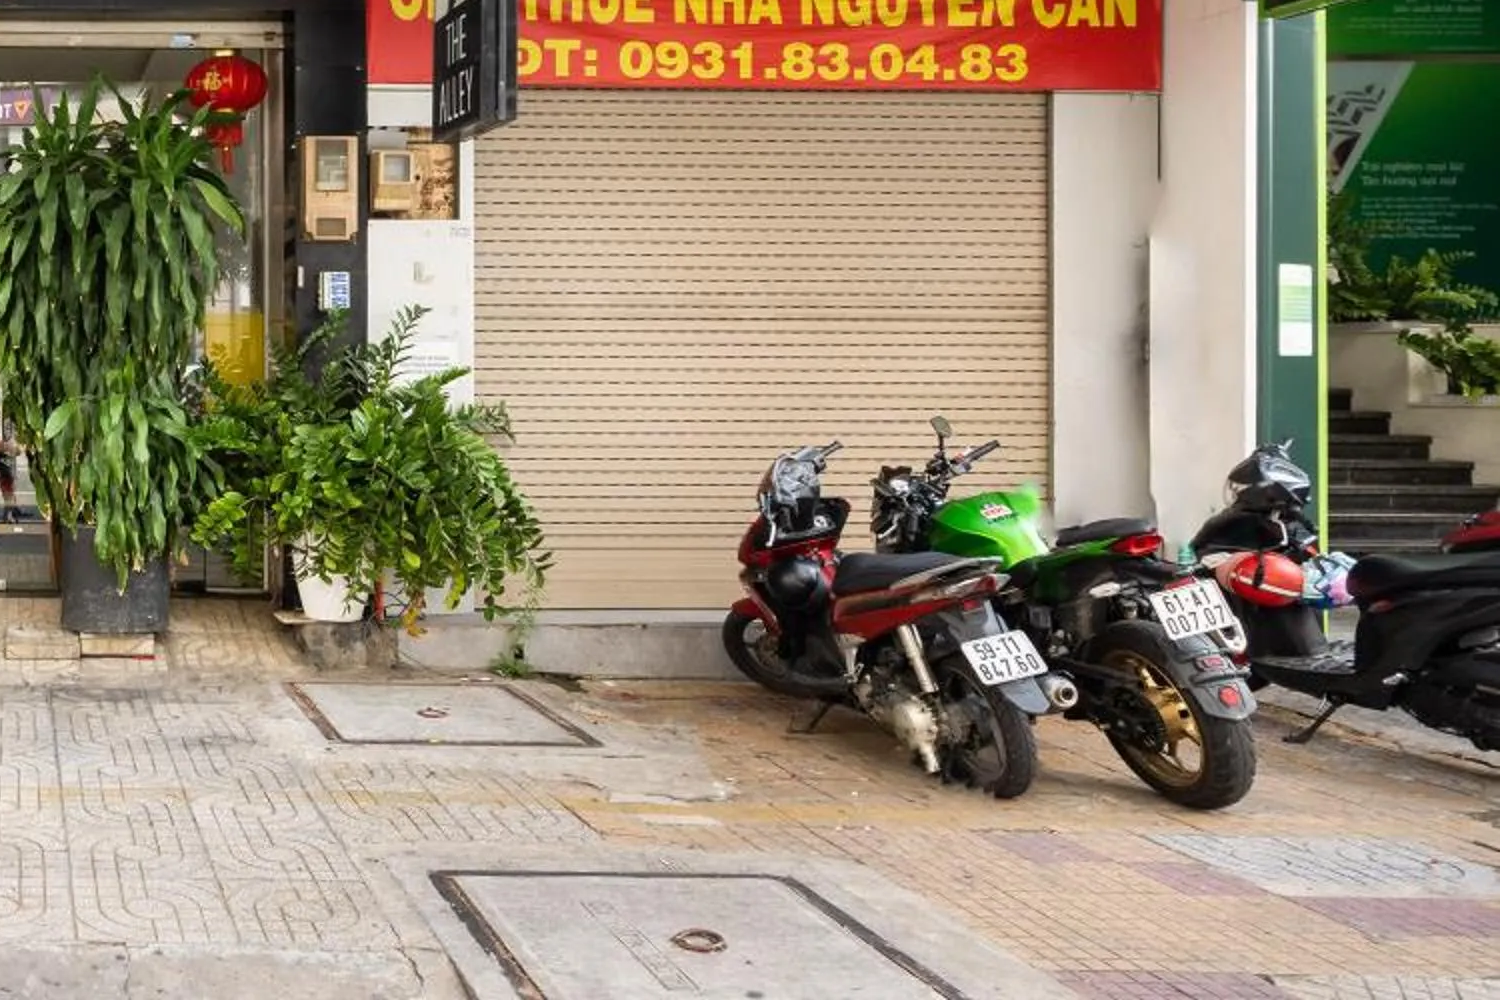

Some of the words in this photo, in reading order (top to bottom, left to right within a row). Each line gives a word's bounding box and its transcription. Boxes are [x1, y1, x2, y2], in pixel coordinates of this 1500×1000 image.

[444, 12, 467, 70] THE
[619, 41, 1028, 82] 0931.83.04.83
[439, 65, 474, 128] ALLEY
